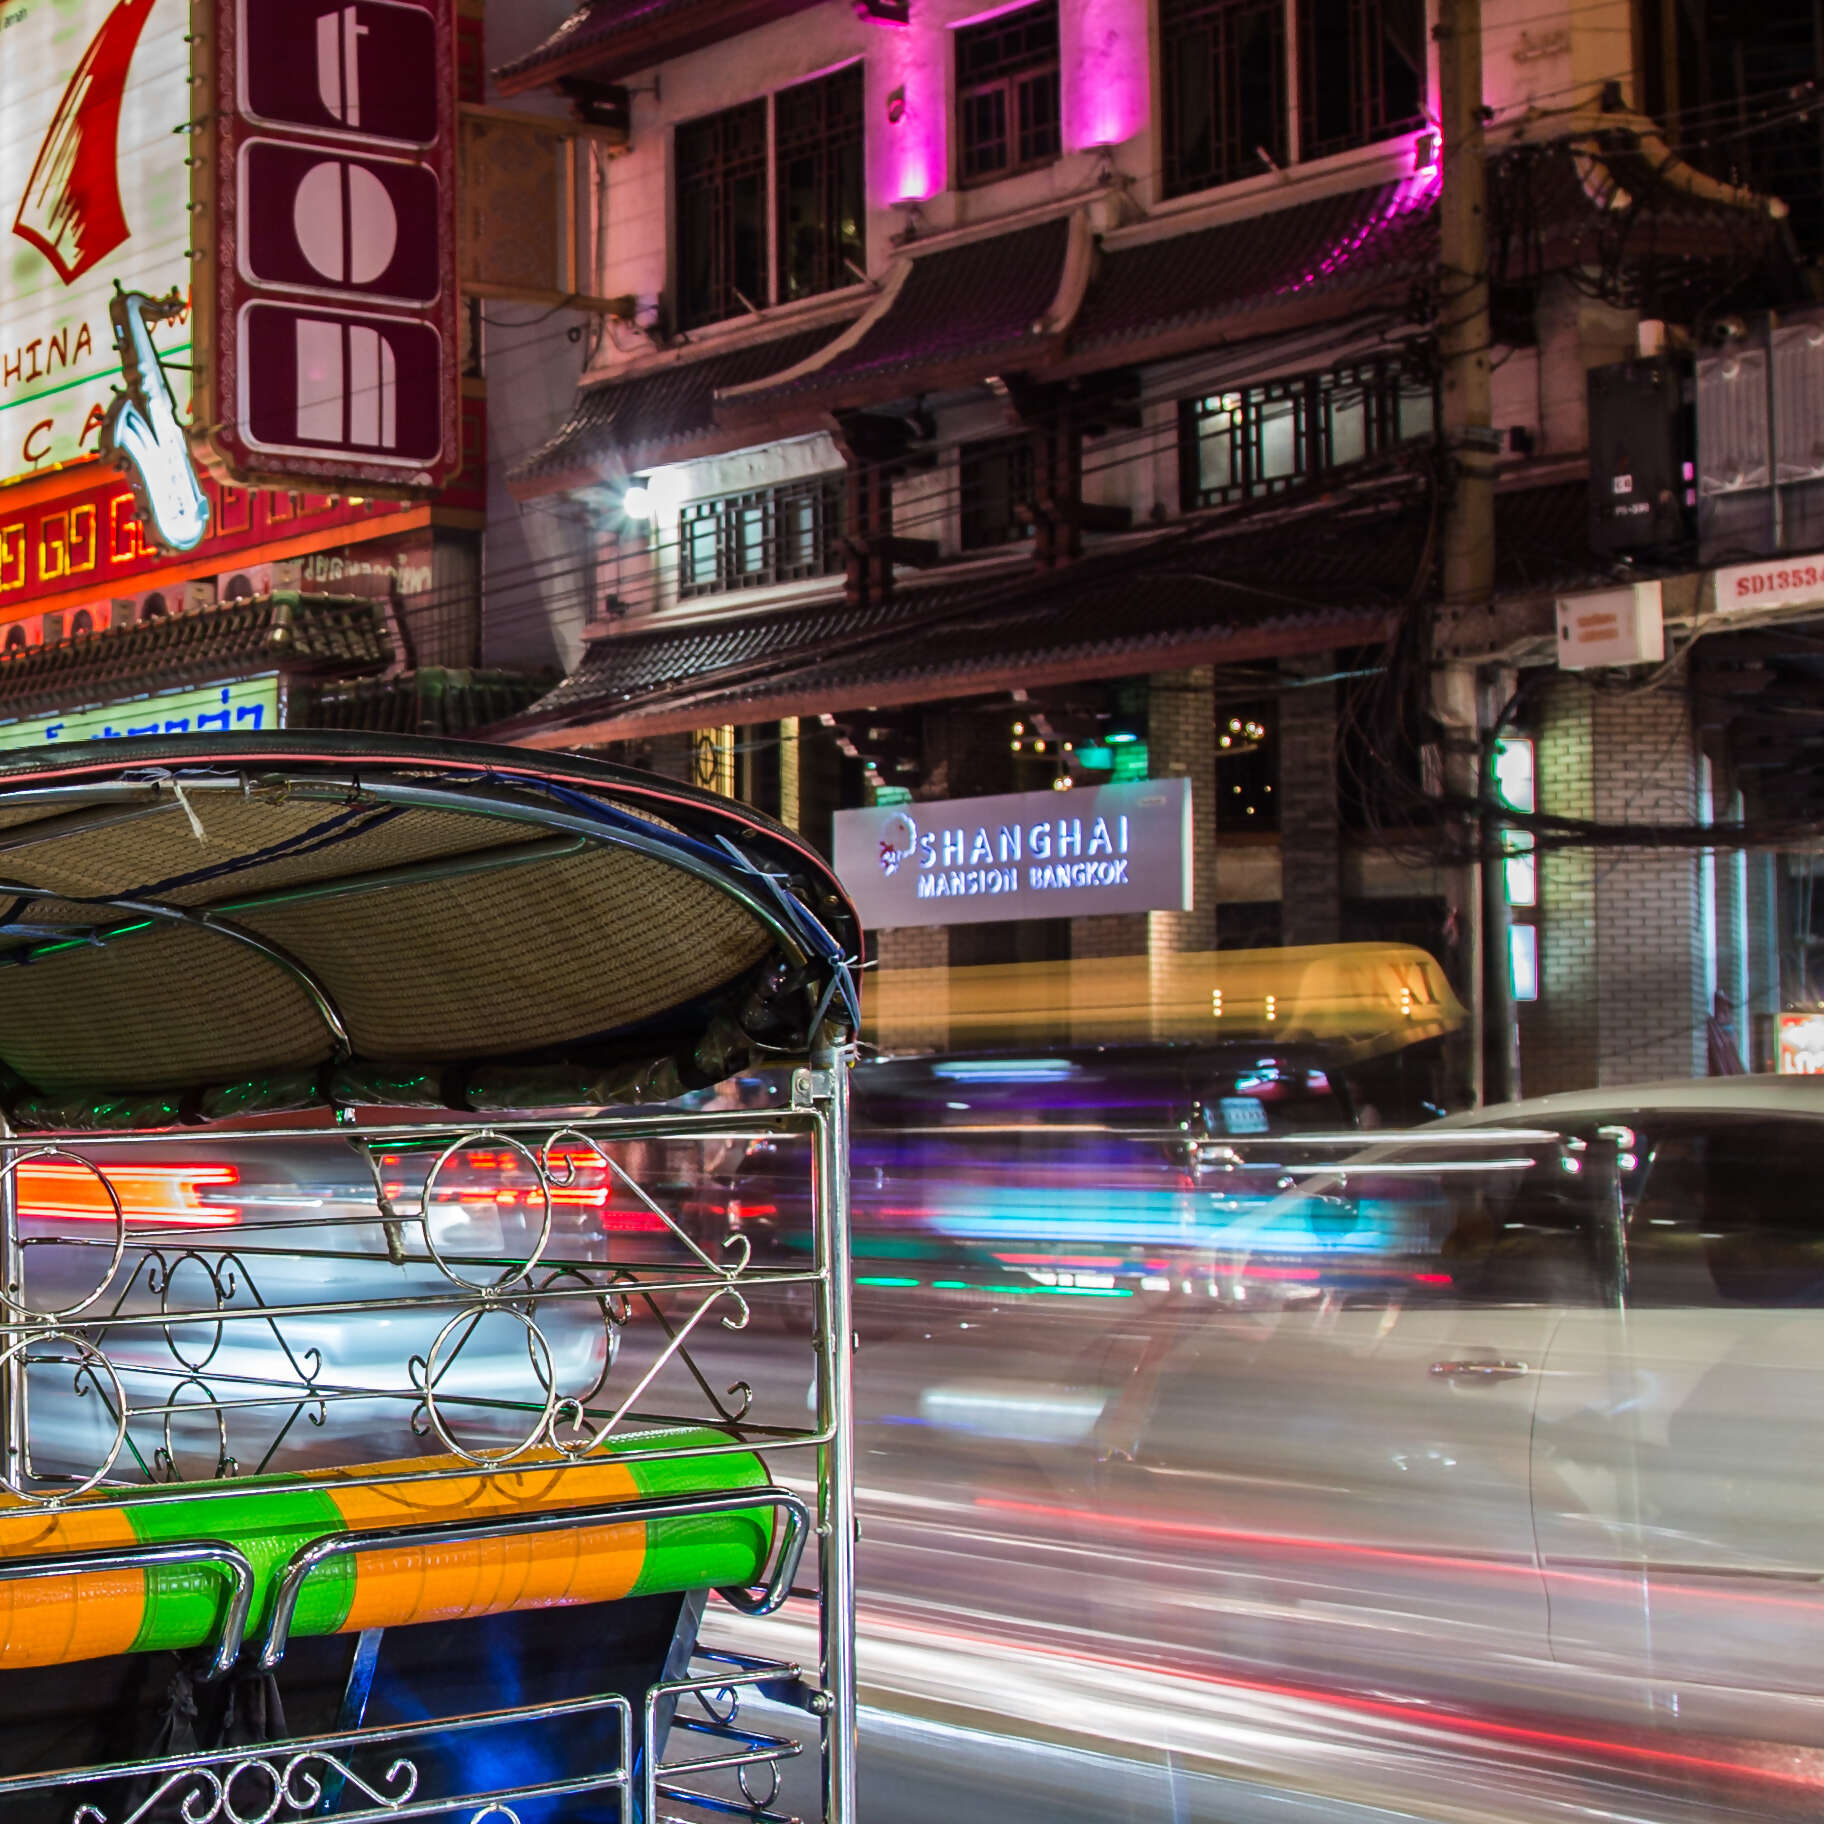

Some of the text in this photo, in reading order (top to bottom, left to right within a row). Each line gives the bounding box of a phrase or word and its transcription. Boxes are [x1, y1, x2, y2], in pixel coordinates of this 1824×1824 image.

[1736, 565, 1824, 598] SD1353
[919, 815, 1129, 870] SHANGHAI
[916, 859, 1129, 900] MANSION BANGKOK
